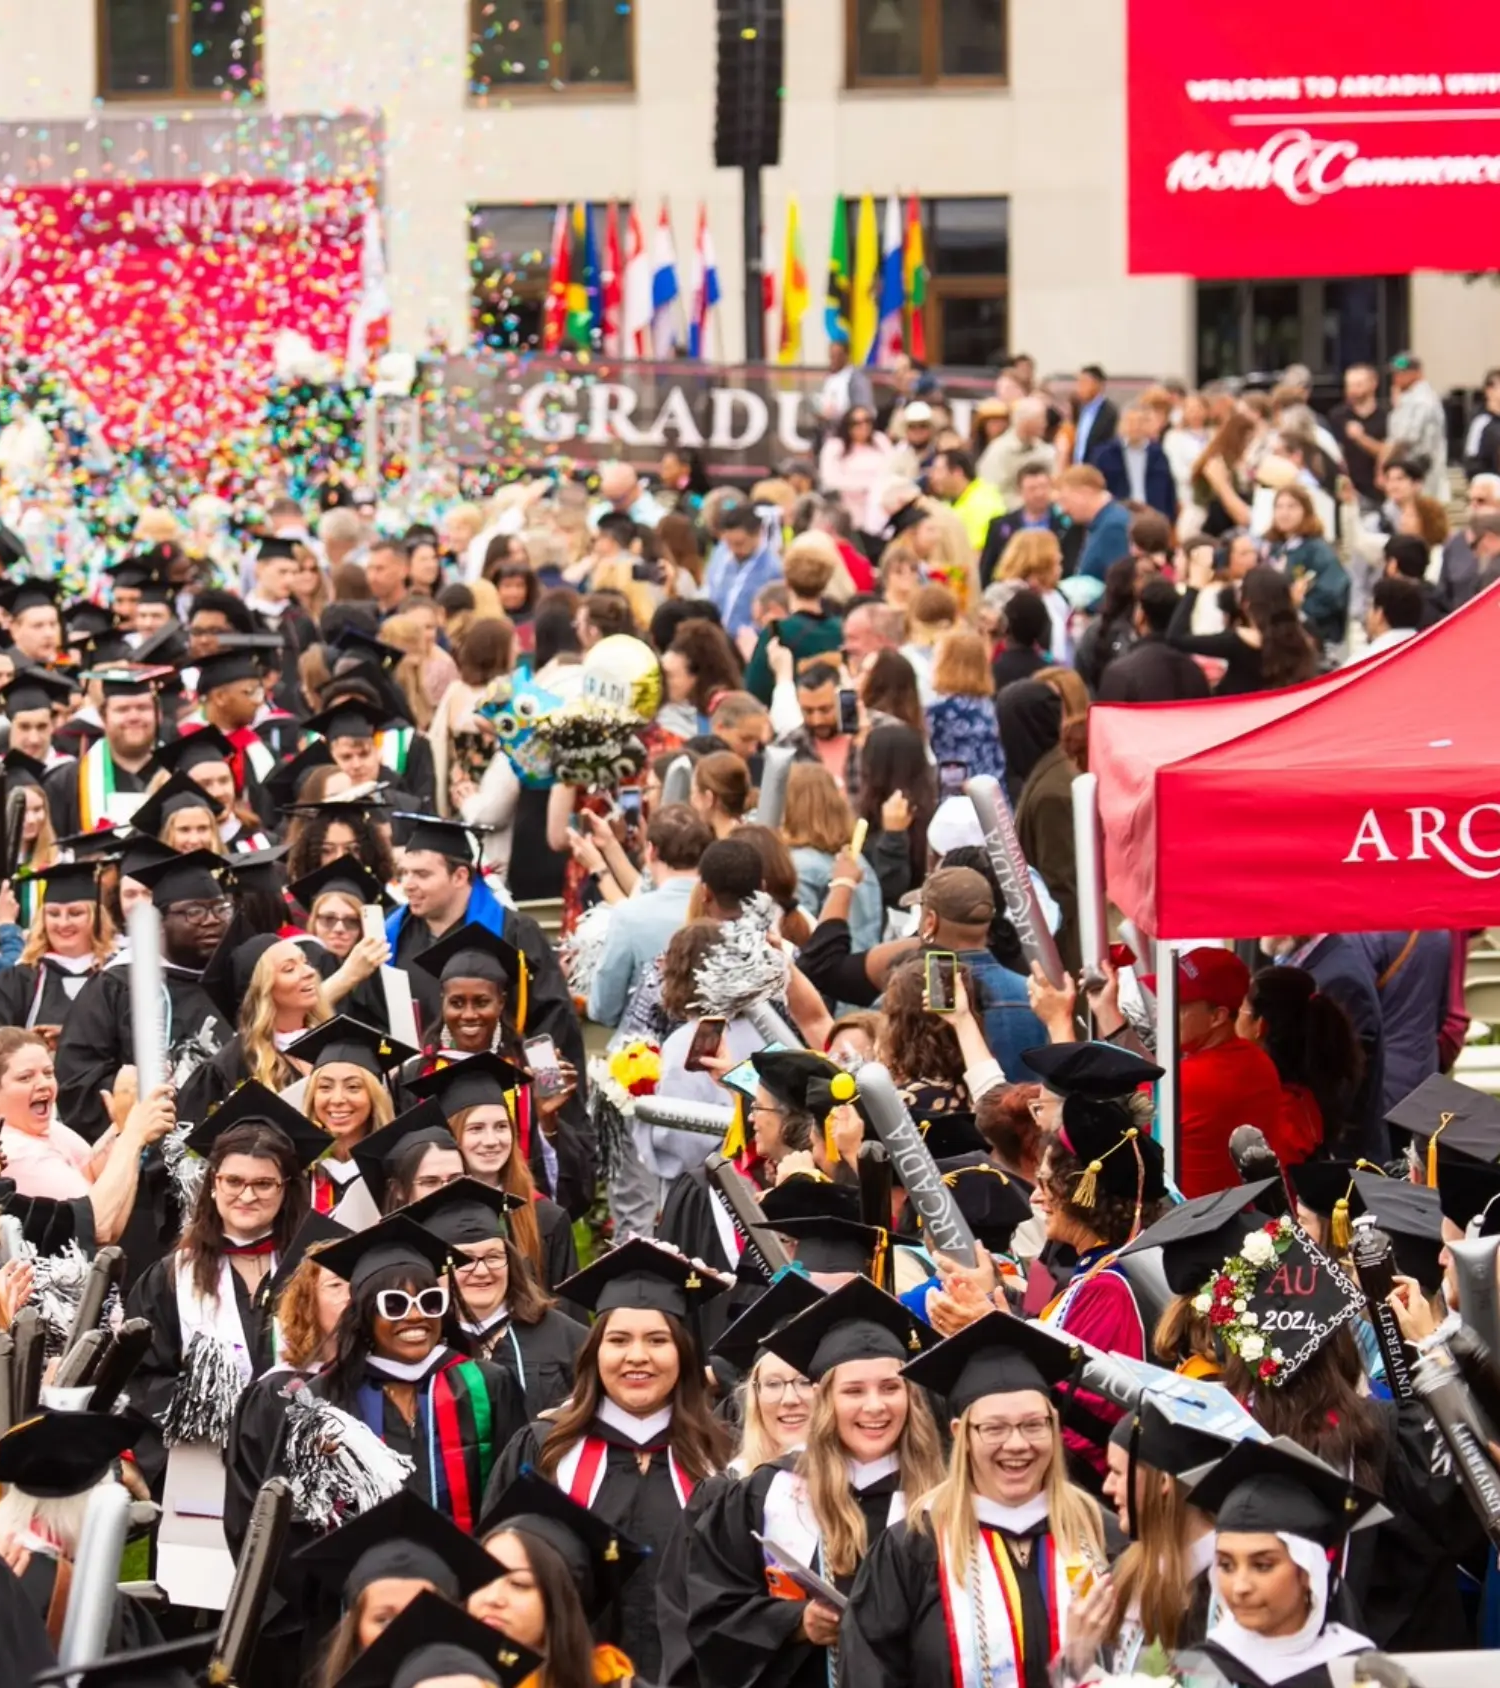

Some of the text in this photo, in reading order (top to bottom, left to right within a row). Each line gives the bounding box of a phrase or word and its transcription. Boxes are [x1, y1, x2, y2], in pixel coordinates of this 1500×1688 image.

[1339, 74, 1443, 97] ARCADIA
[519, 380, 813, 452] GRADU
[984, 826, 1040, 946] ARCADIA
[885, 1121, 969, 1251] ARCADIA
[1264, 1262, 1320, 1296] AU
[1260, 1309, 1318, 1336] 2024
[1375, 1301, 1414, 1398] UNIVERSITY
